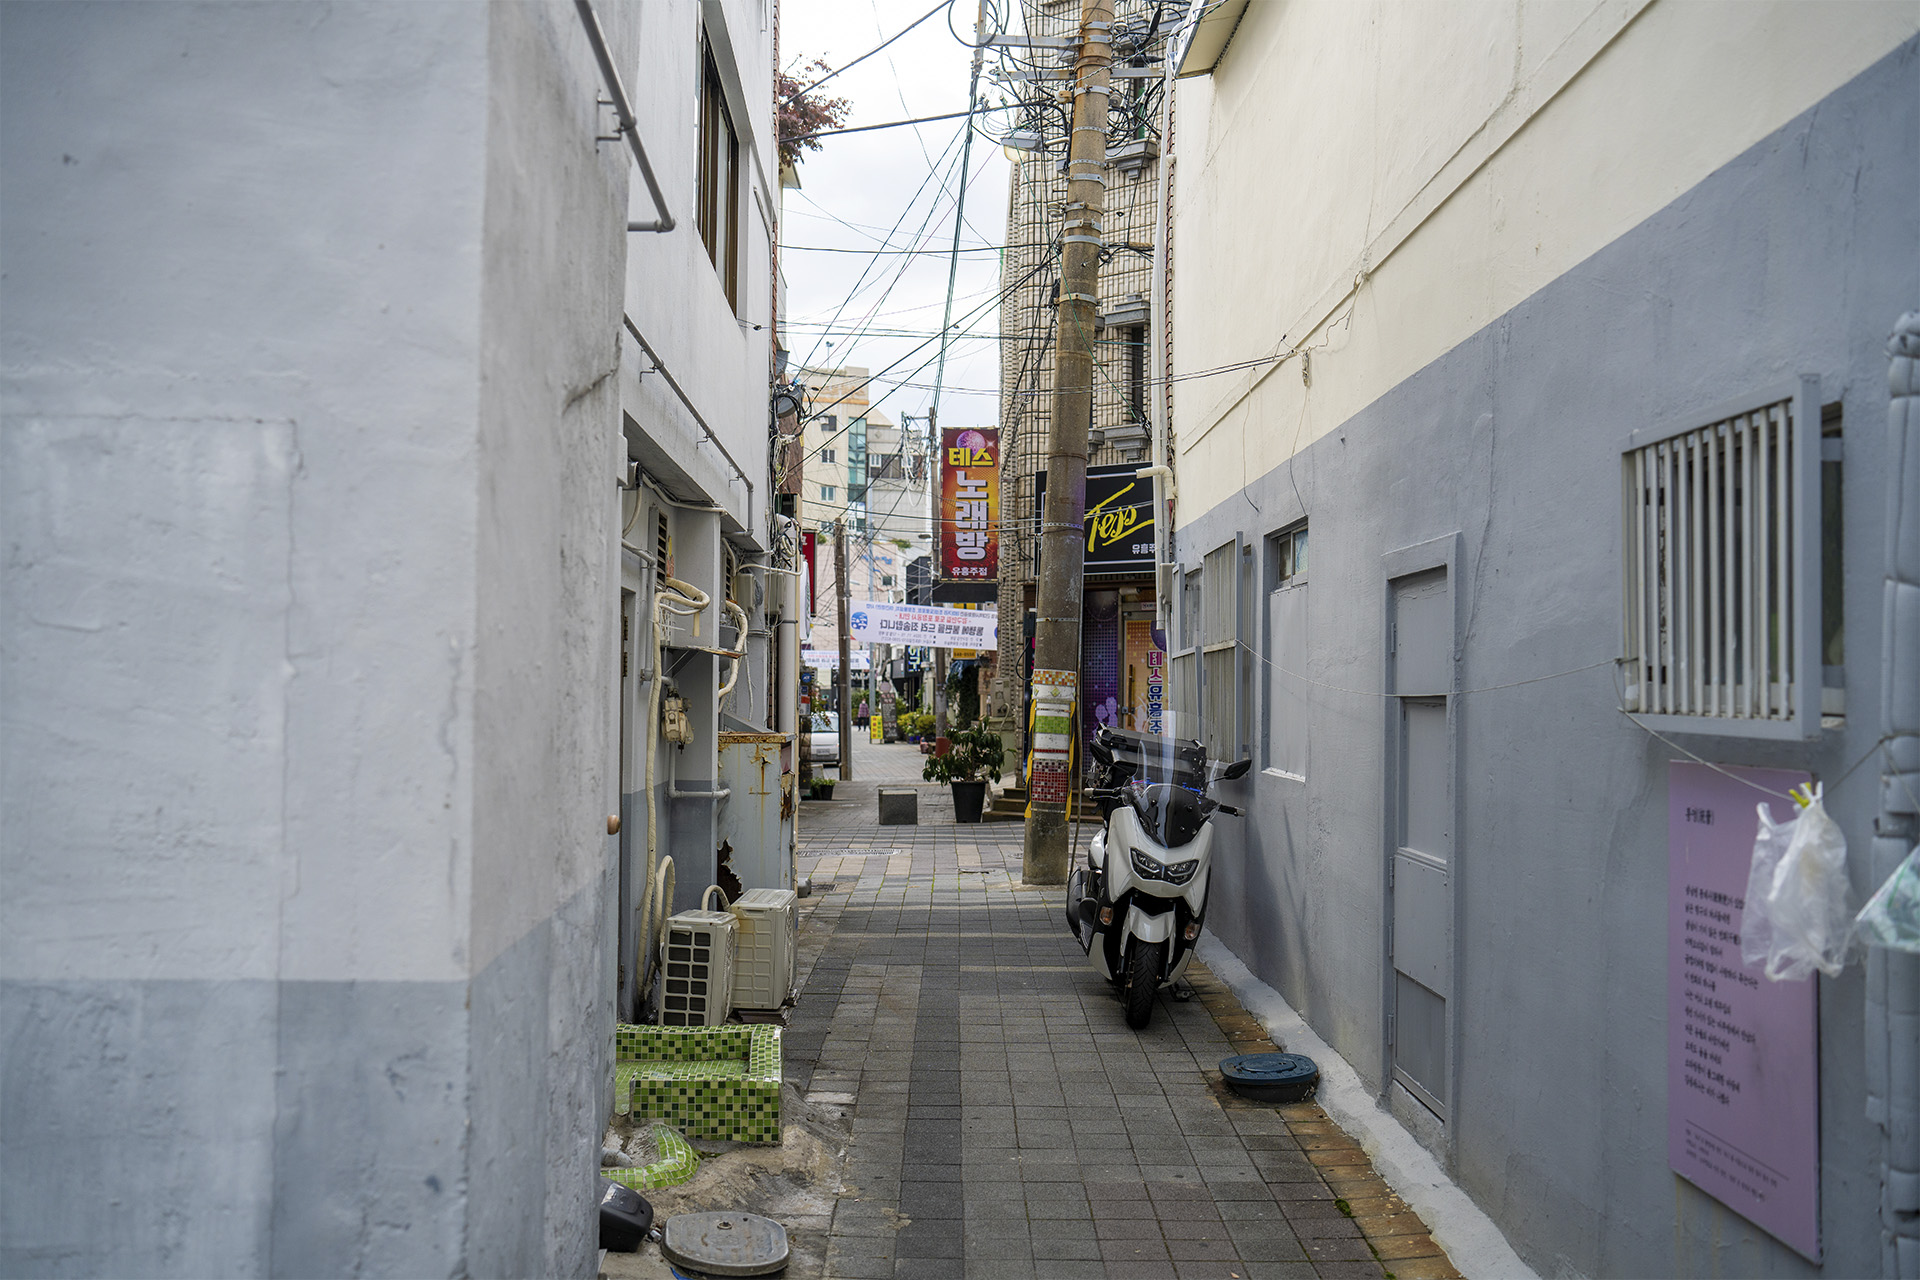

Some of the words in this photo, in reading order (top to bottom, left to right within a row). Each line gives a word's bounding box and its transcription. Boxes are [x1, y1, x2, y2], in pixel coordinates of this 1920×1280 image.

[948, 447, 994, 466] 테스
[955, 470, 989, 560] 노래방
[951, 566, 988, 577] 유흥주점
